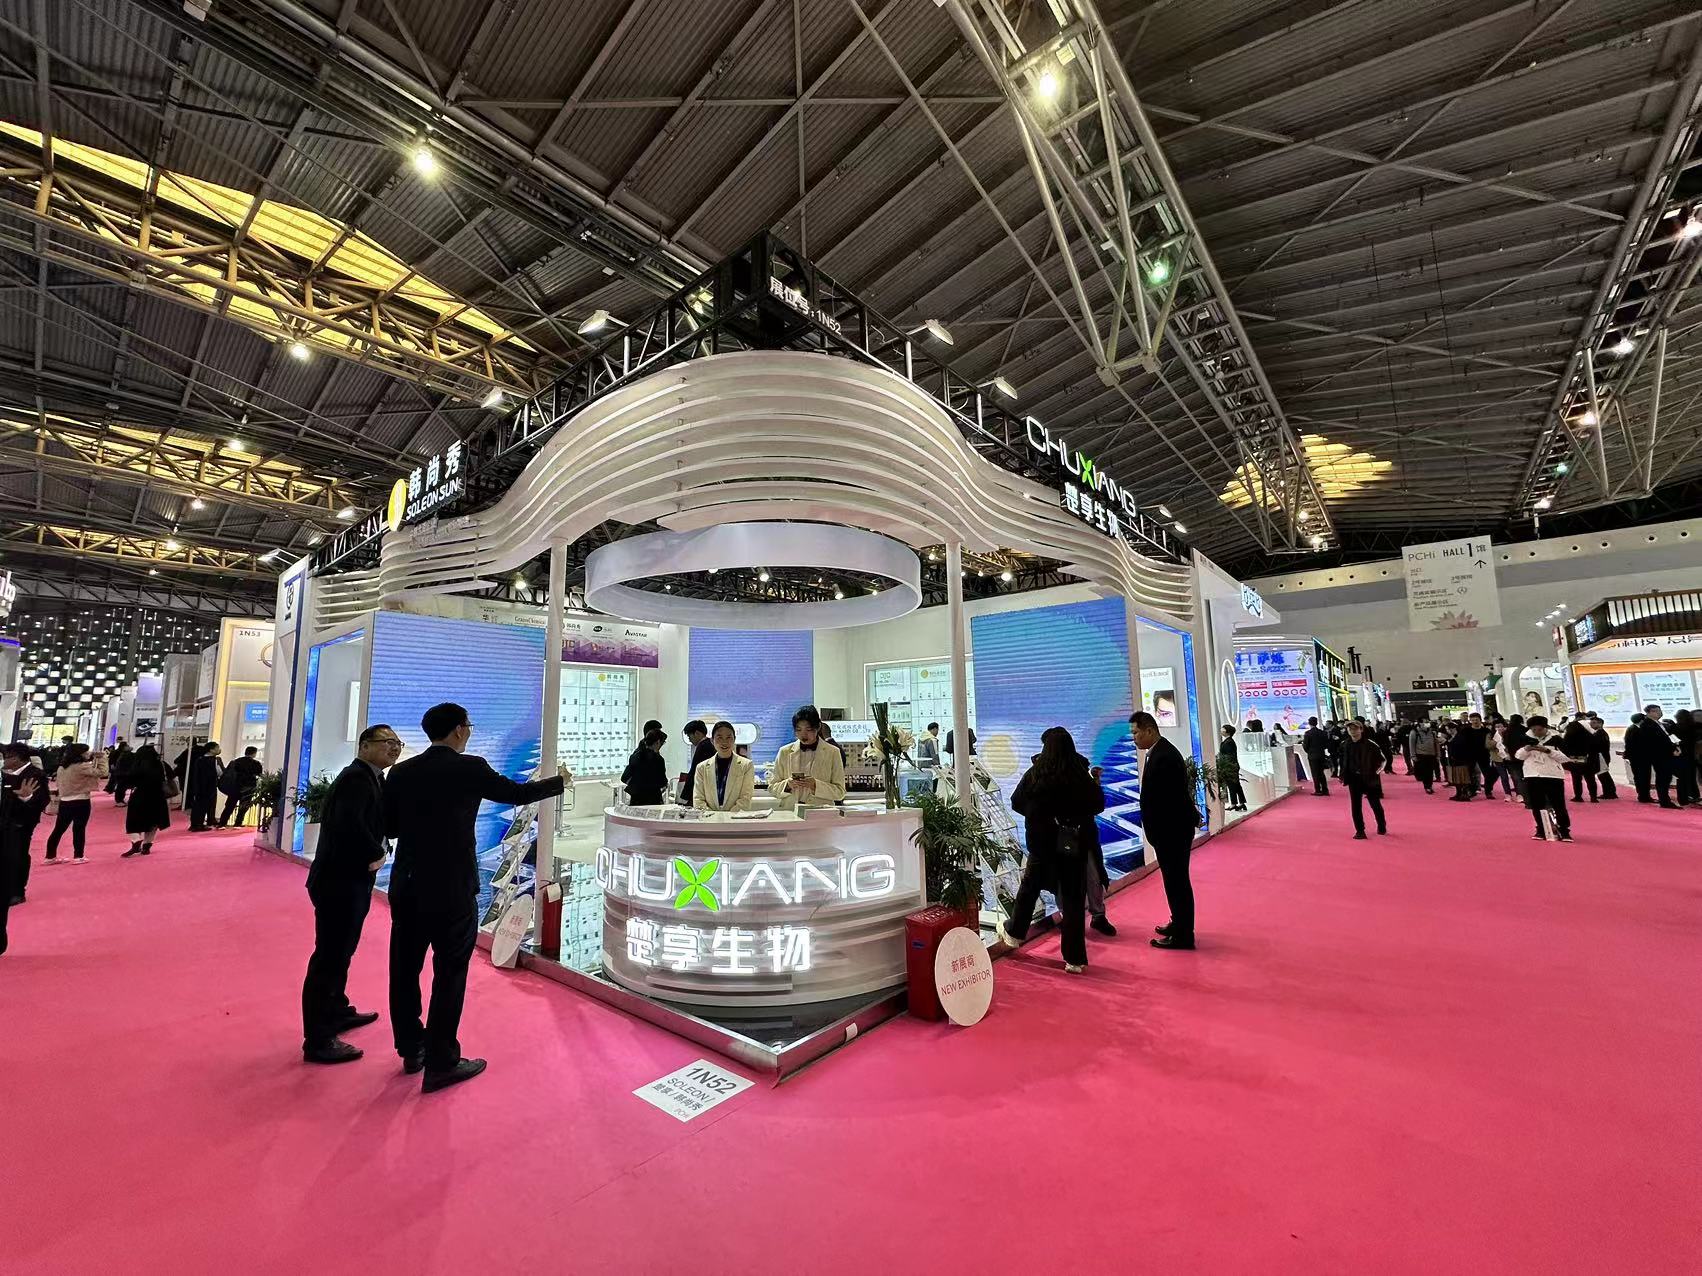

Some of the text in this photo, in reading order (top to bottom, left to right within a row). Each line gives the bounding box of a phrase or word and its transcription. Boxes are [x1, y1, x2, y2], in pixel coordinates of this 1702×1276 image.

[408, 440, 462, 502] 韩尚秀
[1026, 415, 1136, 518] CHUXIANG
[406, 477, 460, 520] SOLEON SUN
[1064, 482, 1121, 539] 楚享生物
[1442, 547, 1465, 557] HALL
[1466, 543, 1473, 558] 1
[1425, 680, 1451, 688] H1-1
[594, 847, 896, 912] CHUXIANG
[626, 916, 813, 974] 楚享生物
[940, 969, 992, 996] NEW EXHIBITOR
[686, 1067, 737, 1095] 1N52
